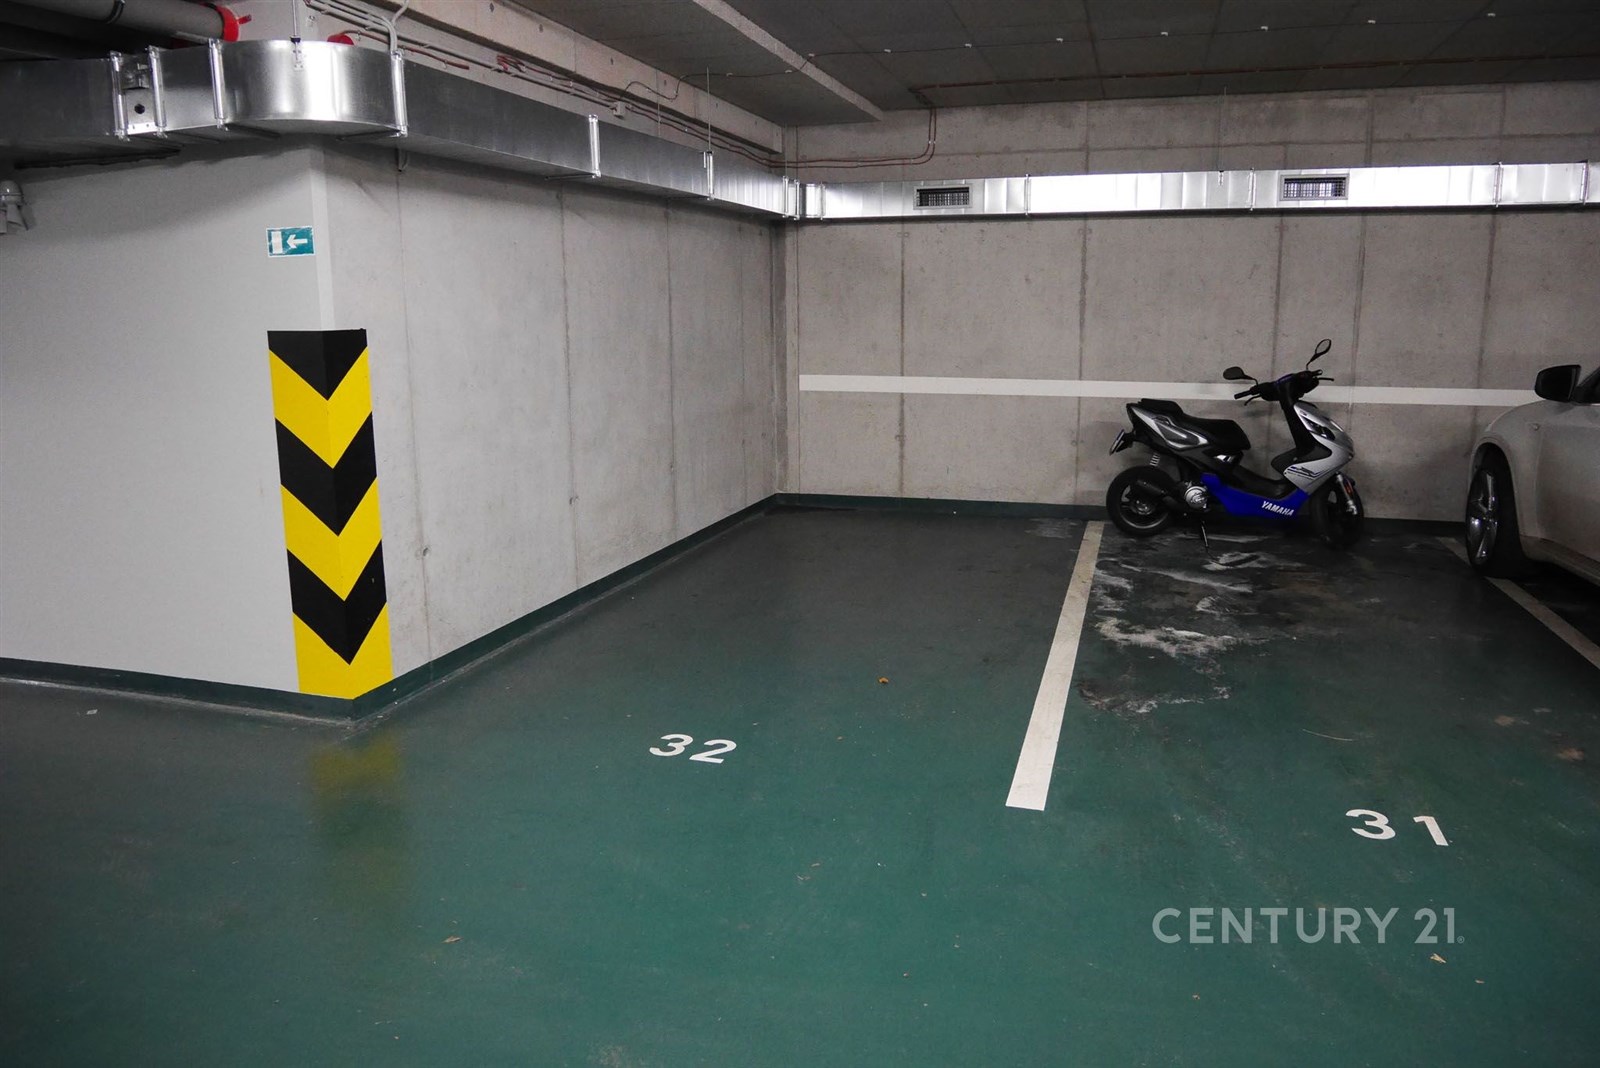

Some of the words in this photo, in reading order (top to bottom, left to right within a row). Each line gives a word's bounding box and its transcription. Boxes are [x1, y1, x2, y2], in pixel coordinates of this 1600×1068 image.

[1261, 500, 1295, 516] YAMAHA
[649, 733, 737, 764] 32
[1345, 808, 1449, 847] 31
